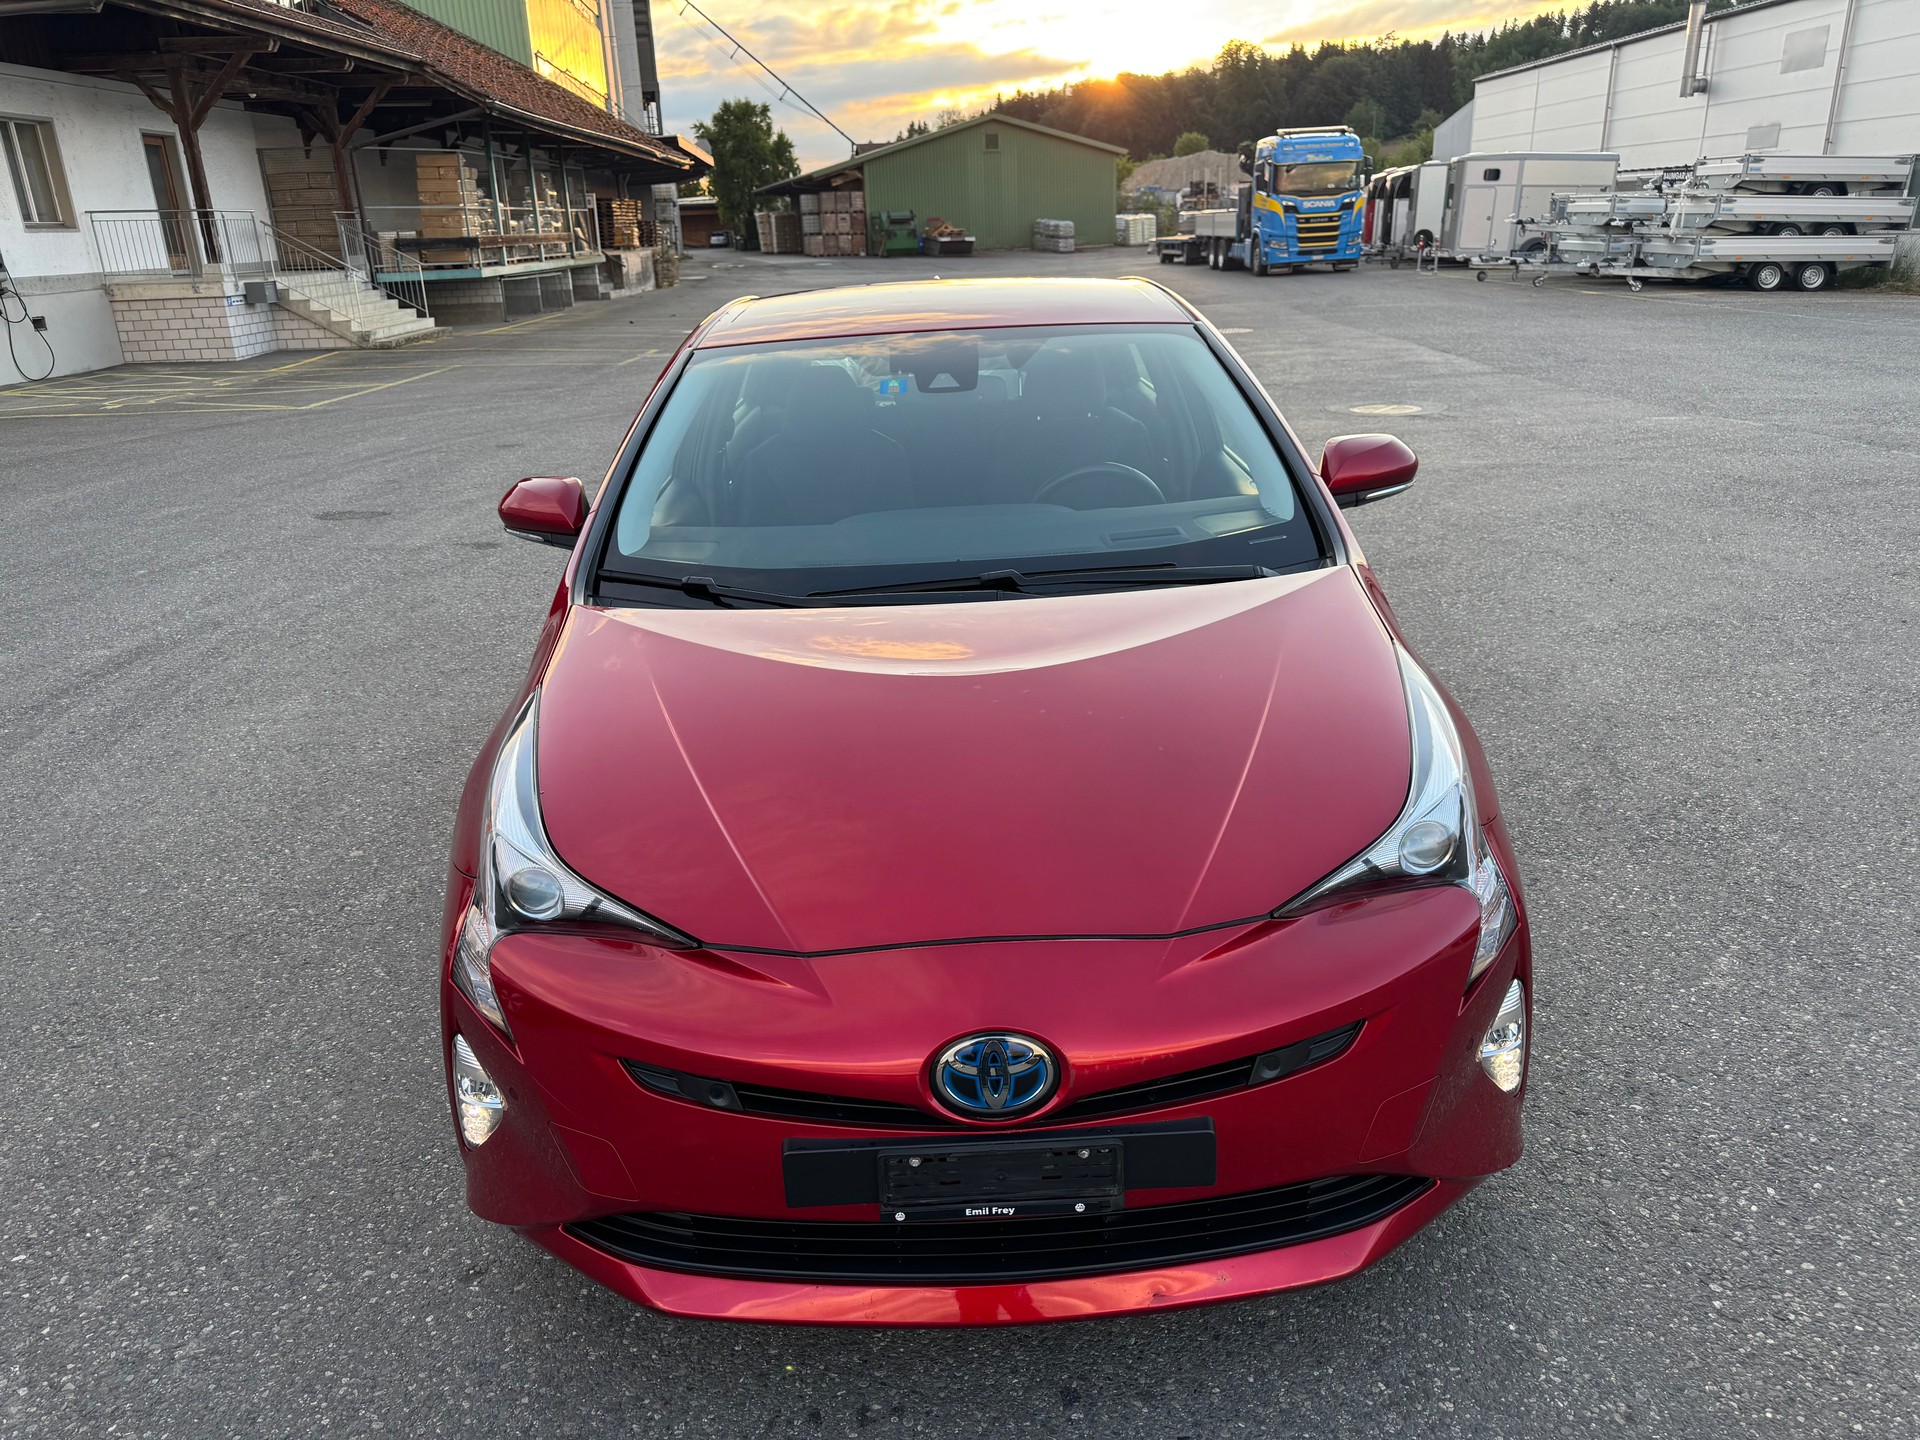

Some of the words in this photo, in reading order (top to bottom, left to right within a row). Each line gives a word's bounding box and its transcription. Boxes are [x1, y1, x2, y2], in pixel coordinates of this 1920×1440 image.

[1303, 200, 1335, 208] SCANIA
[966, 1207, 989, 1216] Emil
[992, 1206, 1015, 1215] Frey
